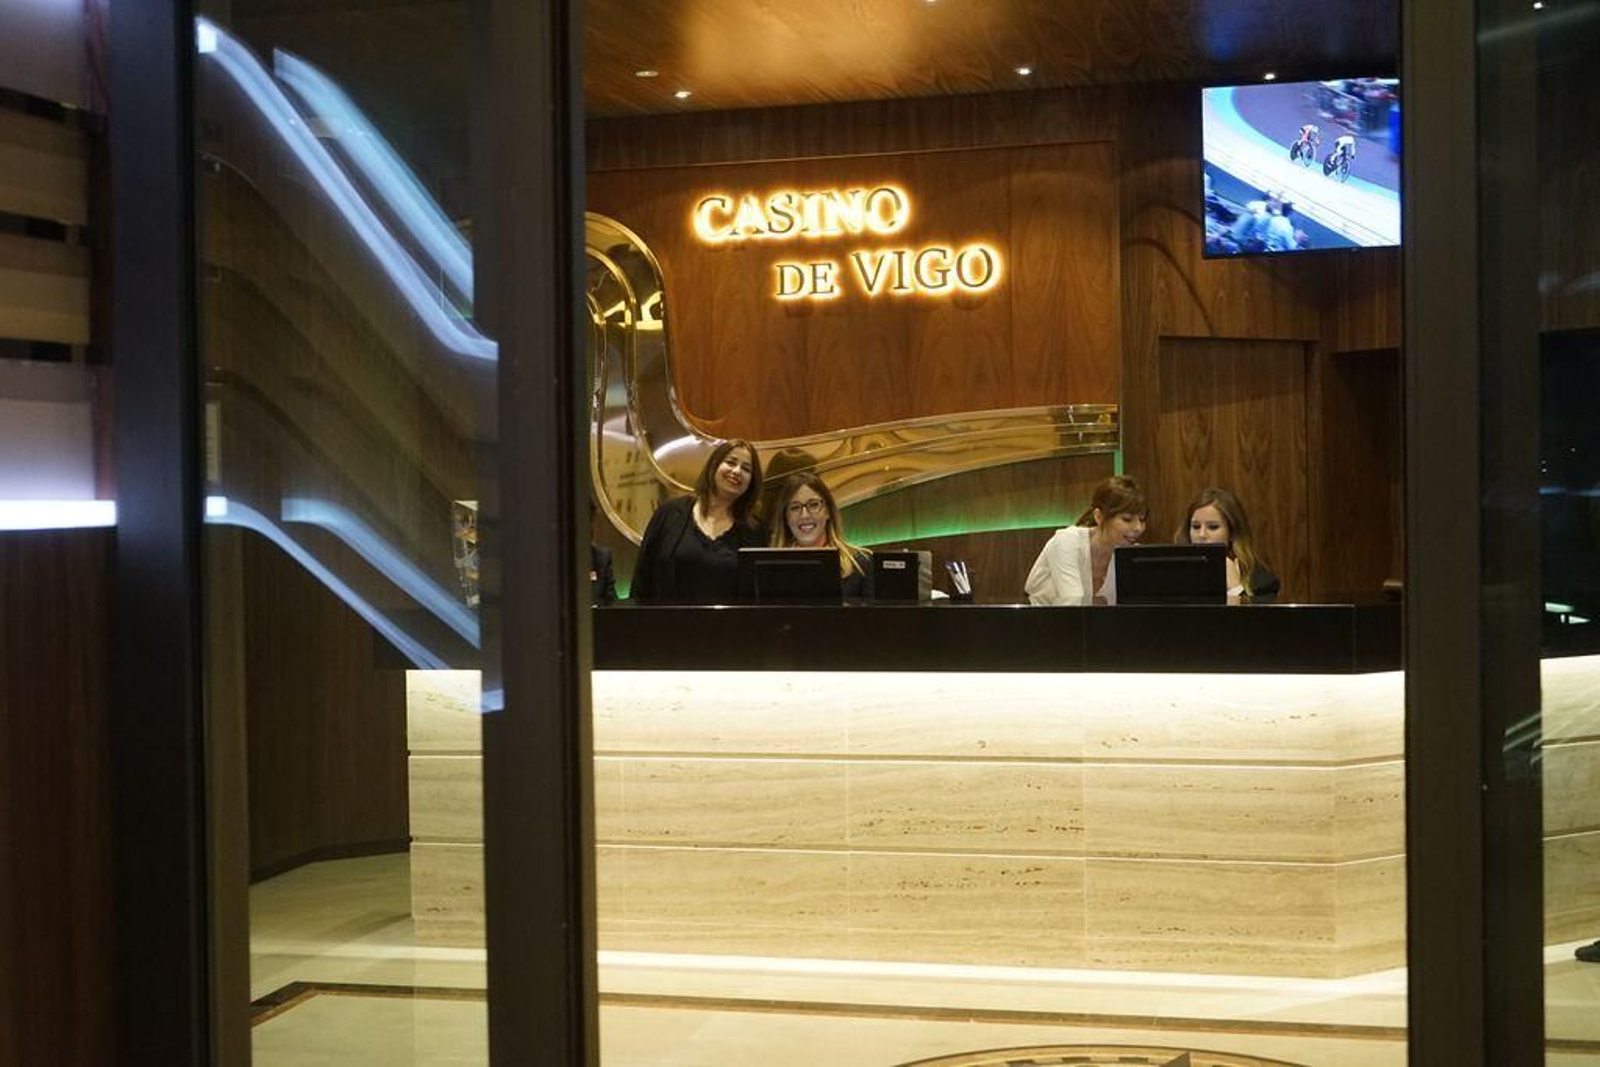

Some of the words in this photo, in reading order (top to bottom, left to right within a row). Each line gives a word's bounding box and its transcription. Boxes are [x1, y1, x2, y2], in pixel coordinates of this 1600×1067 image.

[694, 187, 906, 240] CASINO
[776, 262, 836, 297] DE
[851, 246, 996, 293] VIGO
